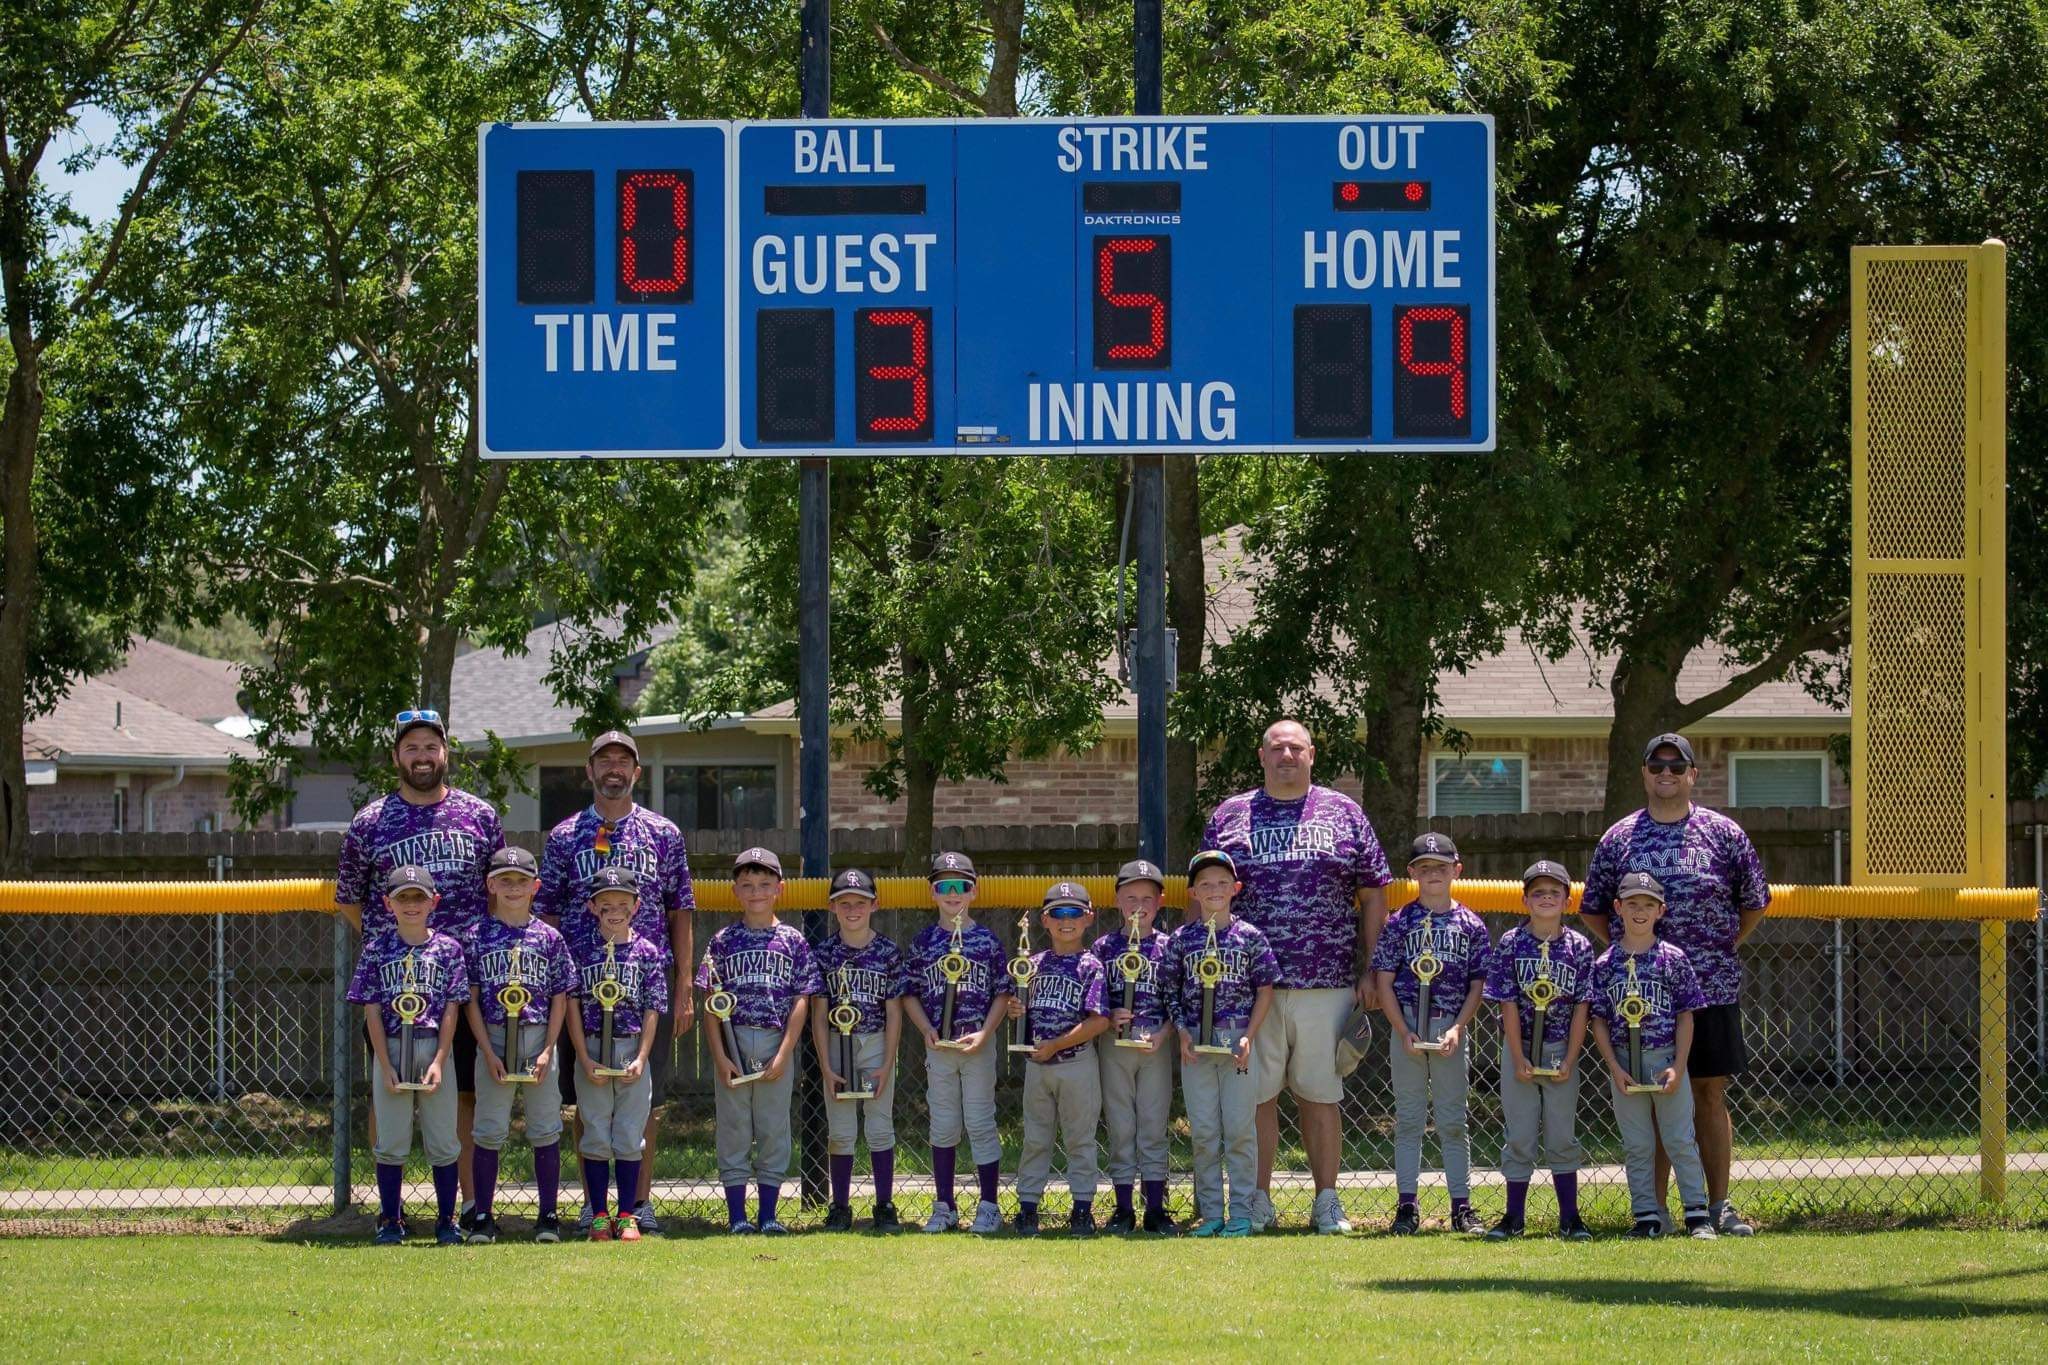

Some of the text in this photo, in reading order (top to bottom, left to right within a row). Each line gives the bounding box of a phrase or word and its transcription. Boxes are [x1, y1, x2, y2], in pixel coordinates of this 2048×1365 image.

[794, 129, 895, 173] BALL
[1057, 127, 1208, 172] STRIKE
[1338, 125, 1424, 170] OUT
[622, 174, 688, 293] 0
[1084, 216, 1181, 225] DAKTRONICS
[752, 233, 937, 295] GUEST
[1304, 230, 1461, 289] HOME
[1100, 239, 1165, 359] 5
[534, 313, 677, 372] TIME
[1400, 308, 1464, 420] 9
[868, 312, 927, 431] 3
[1029, 382, 1236, 441] INNING
[390, 831, 475, 867] WYLIE
[1247, 825, 1336, 859] WYLIE
[1262, 851, 1320, 864] BASEBALL
[1629, 848, 1712, 872] WYLIE
[726, 950, 793, 985] WYLIE
[924, 958, 987, 992] WLIE
[1184, 947, 1249, 980] WLIE
[1606, 981, 1672, 1013] WLIE
